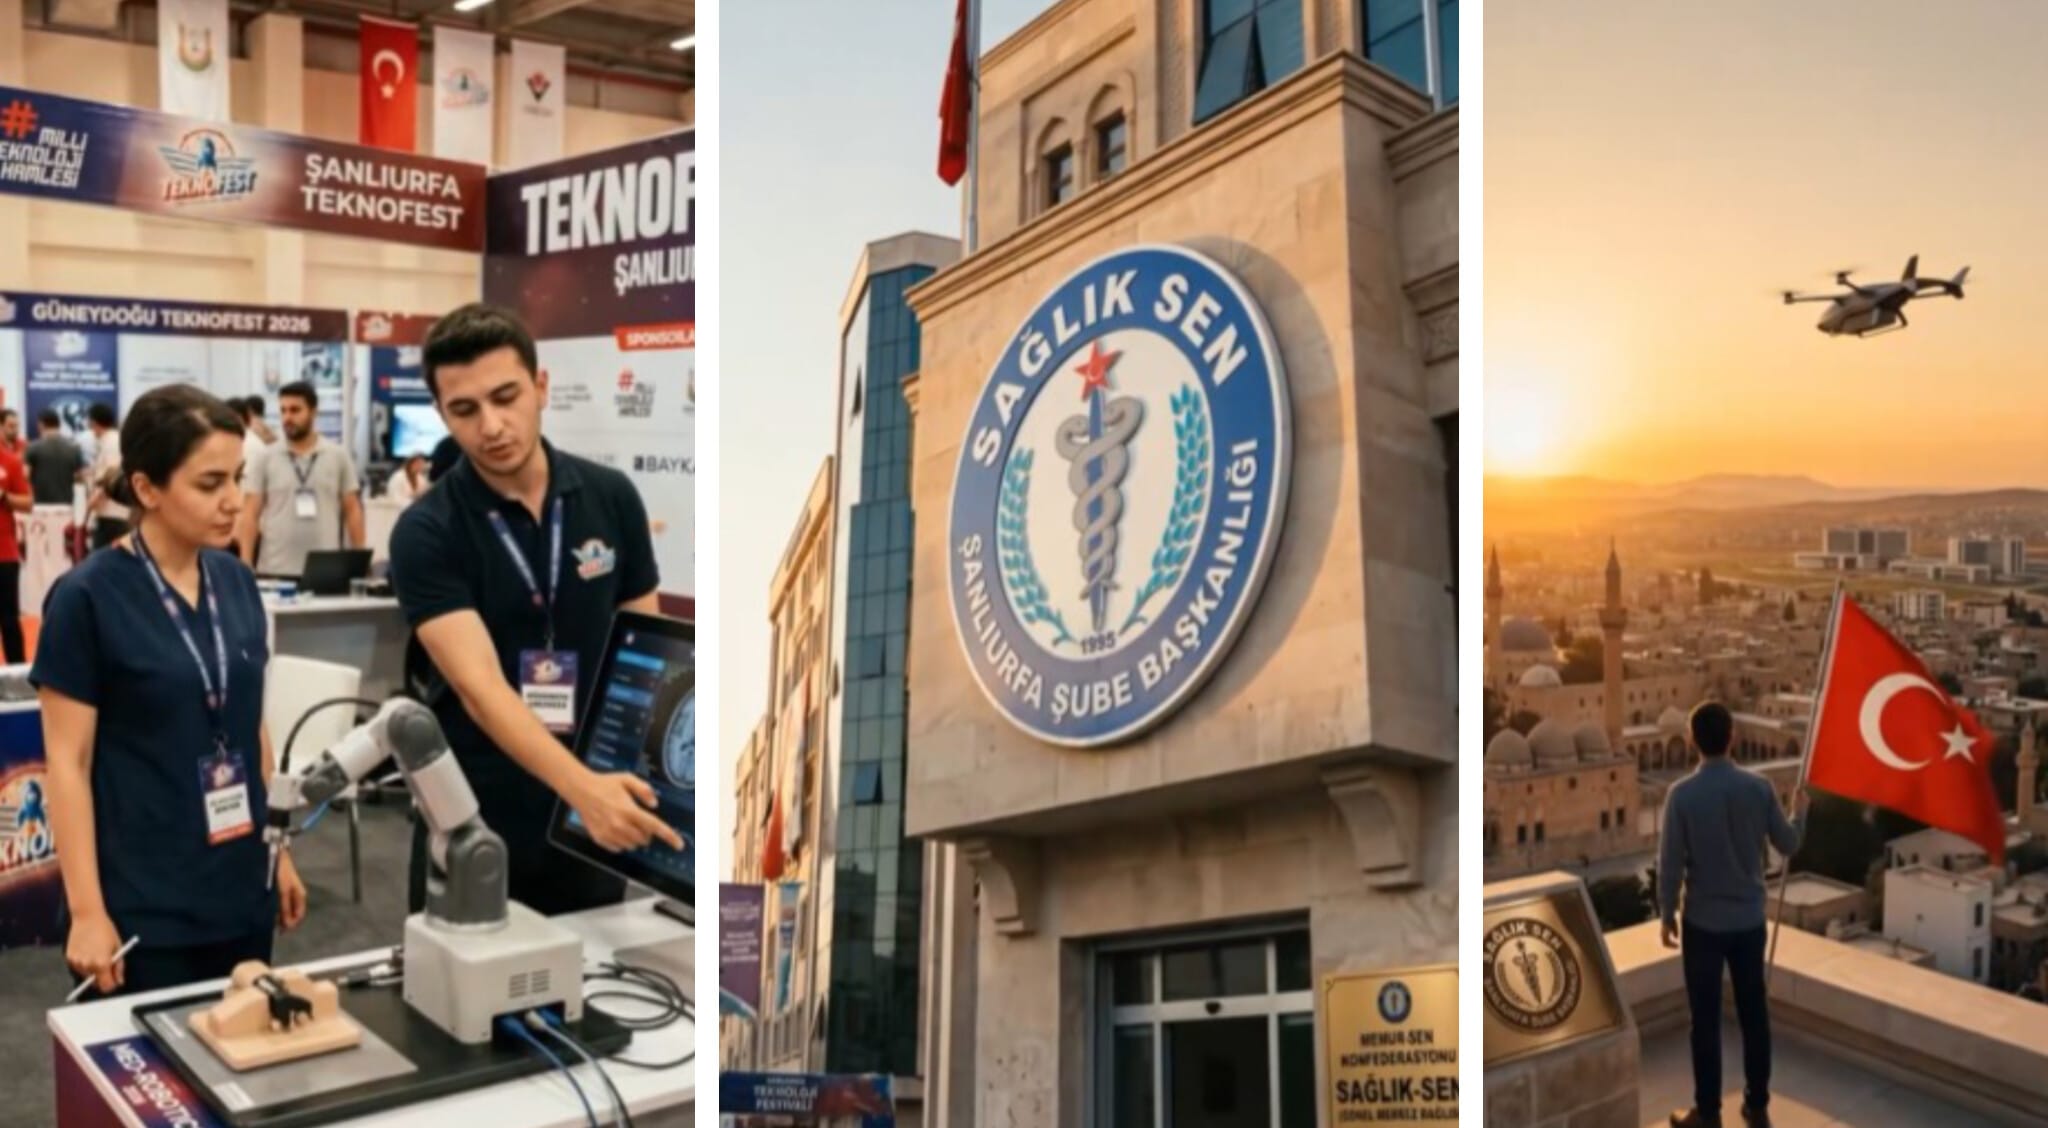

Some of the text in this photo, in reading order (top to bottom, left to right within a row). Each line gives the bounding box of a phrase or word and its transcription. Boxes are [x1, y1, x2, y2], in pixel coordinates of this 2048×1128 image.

[305, 153, 462, 199] ŞANLIURFA
[301, 185, 464, 231] TEKNOFEST
[32, 300, 311, 333] GÜNEYDOĞU TEKNOFEST 2026
[972, 269, 1248, 468] SAĞLIK SEN
[645, 455, 695, 475] BAYK
[958, 438, 1258, 724] ŞANLIURFA ŞUBE BAŞKANLIĞI
